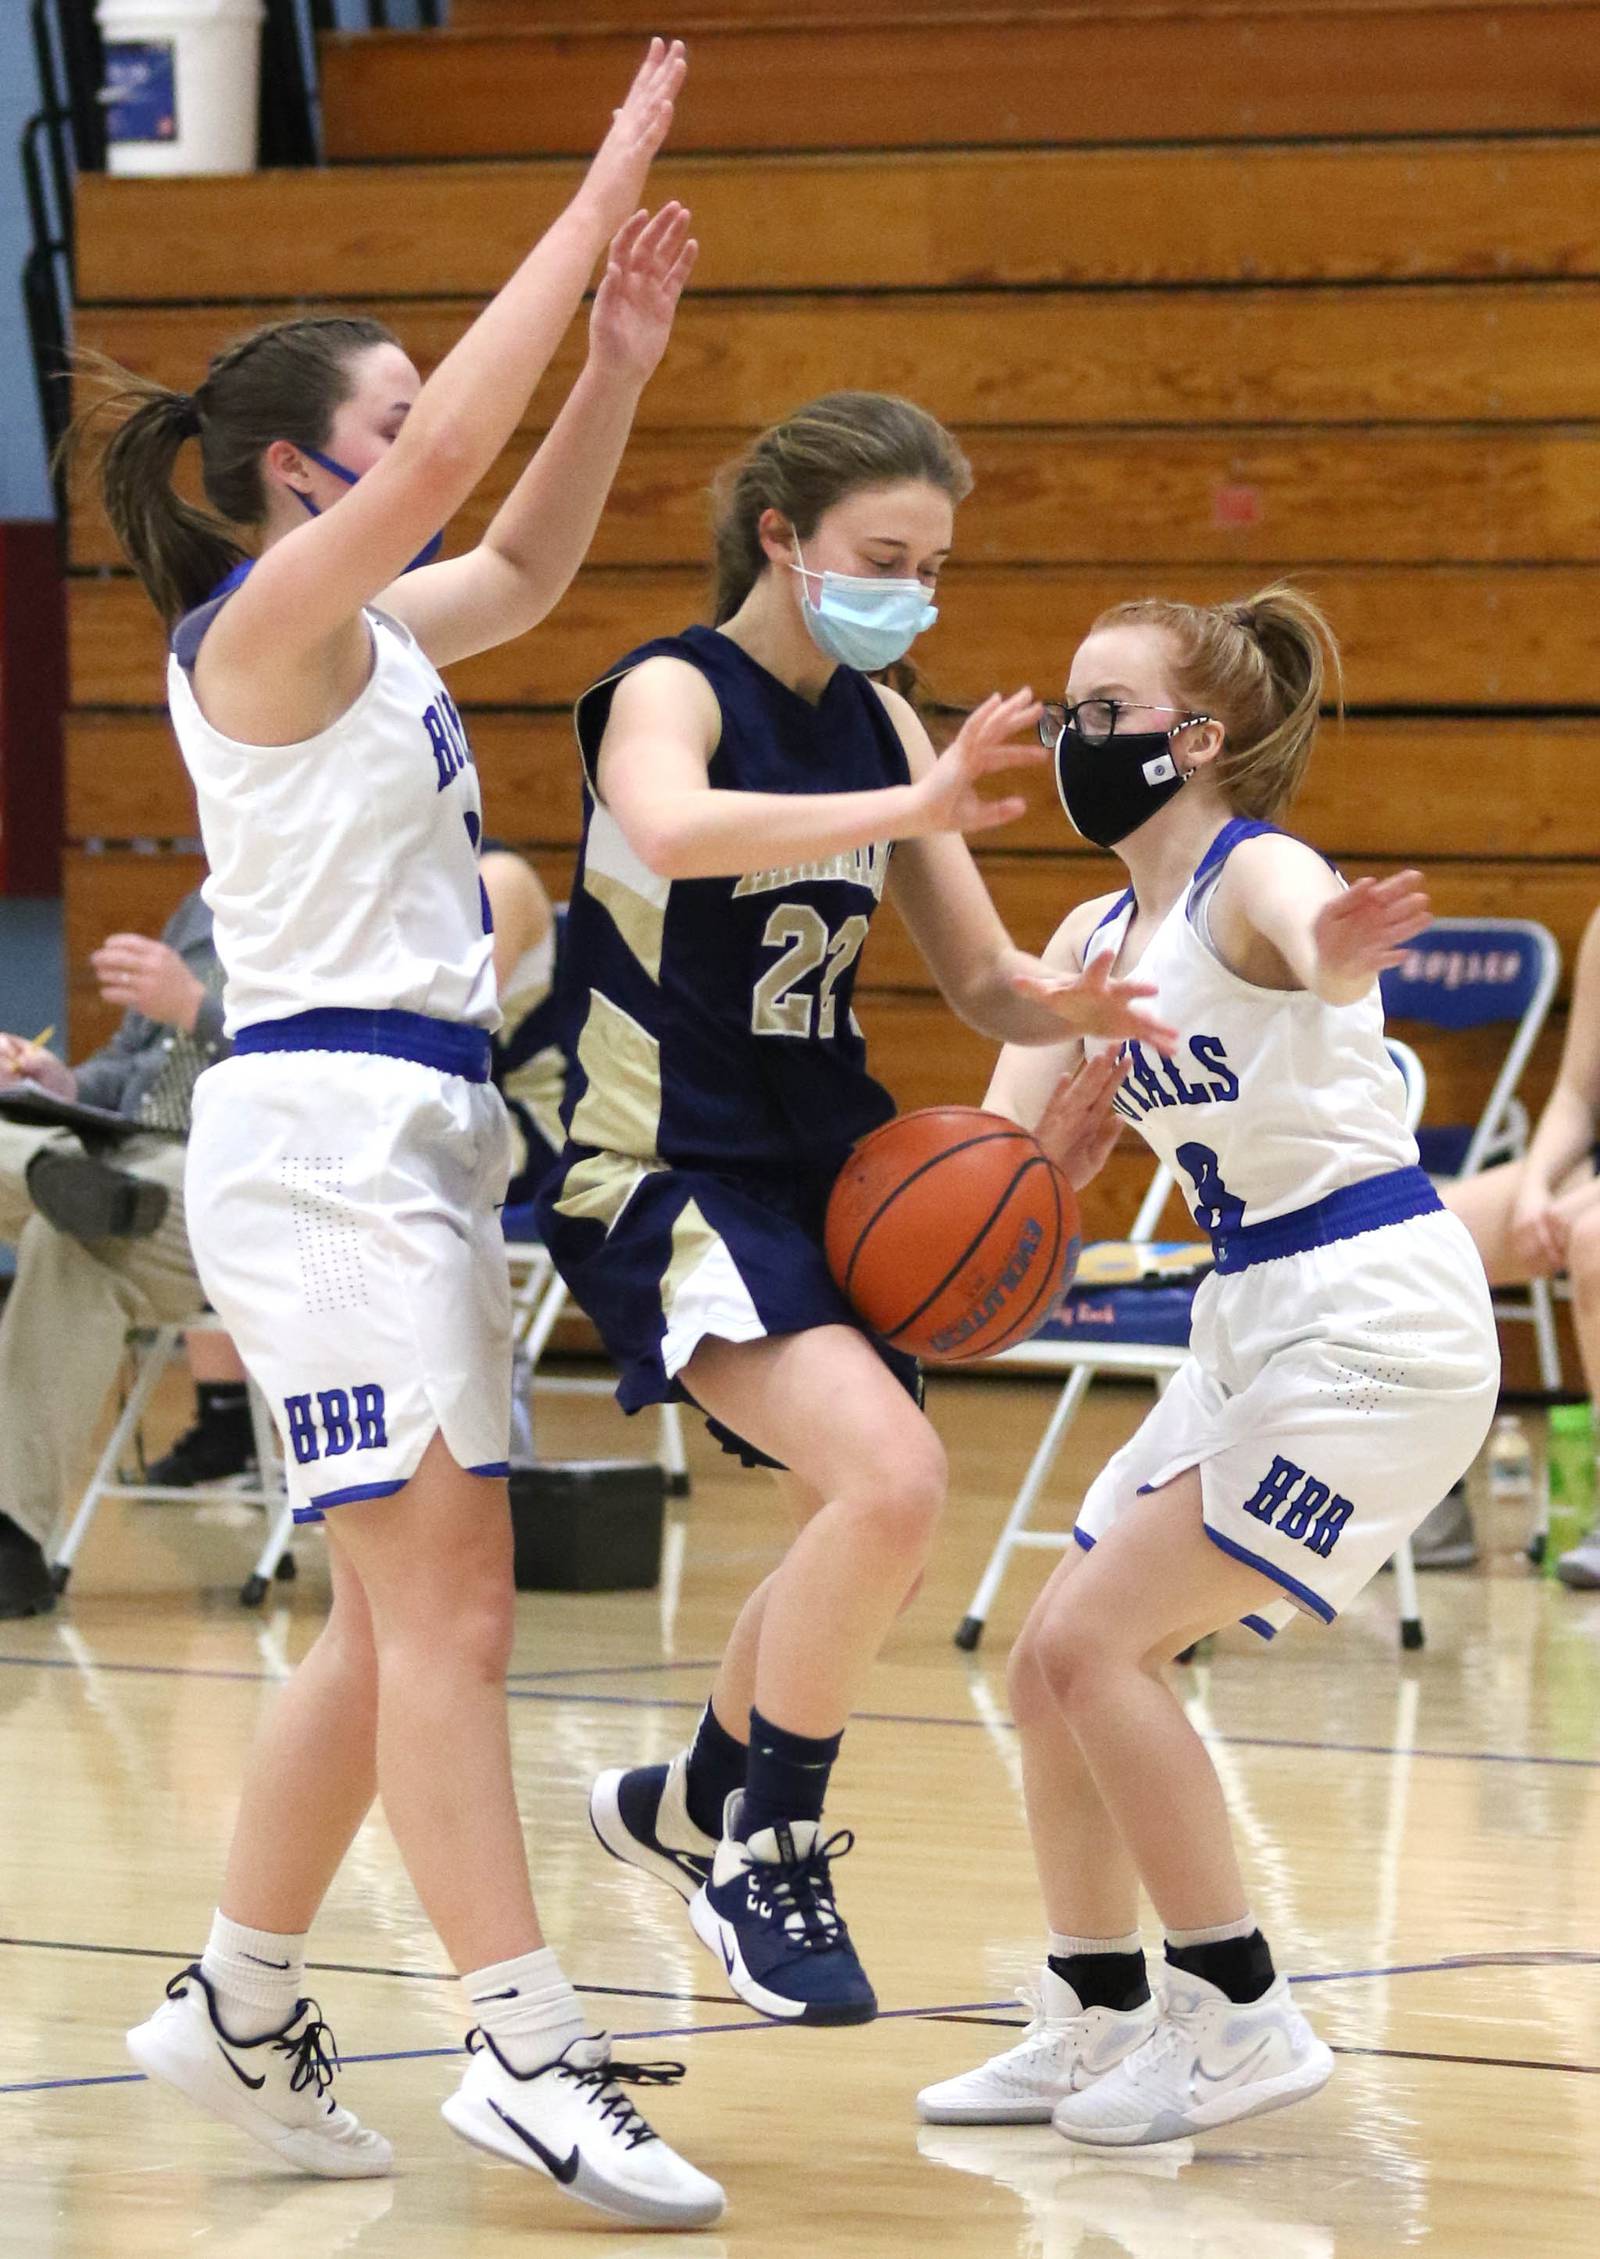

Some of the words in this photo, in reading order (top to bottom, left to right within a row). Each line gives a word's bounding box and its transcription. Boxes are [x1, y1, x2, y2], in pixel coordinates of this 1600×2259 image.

[752, 903, 869, 1039] 22
[284, 1383, 388, 1465] HBR
[1243, 1454, 1355, 1559] HBR
